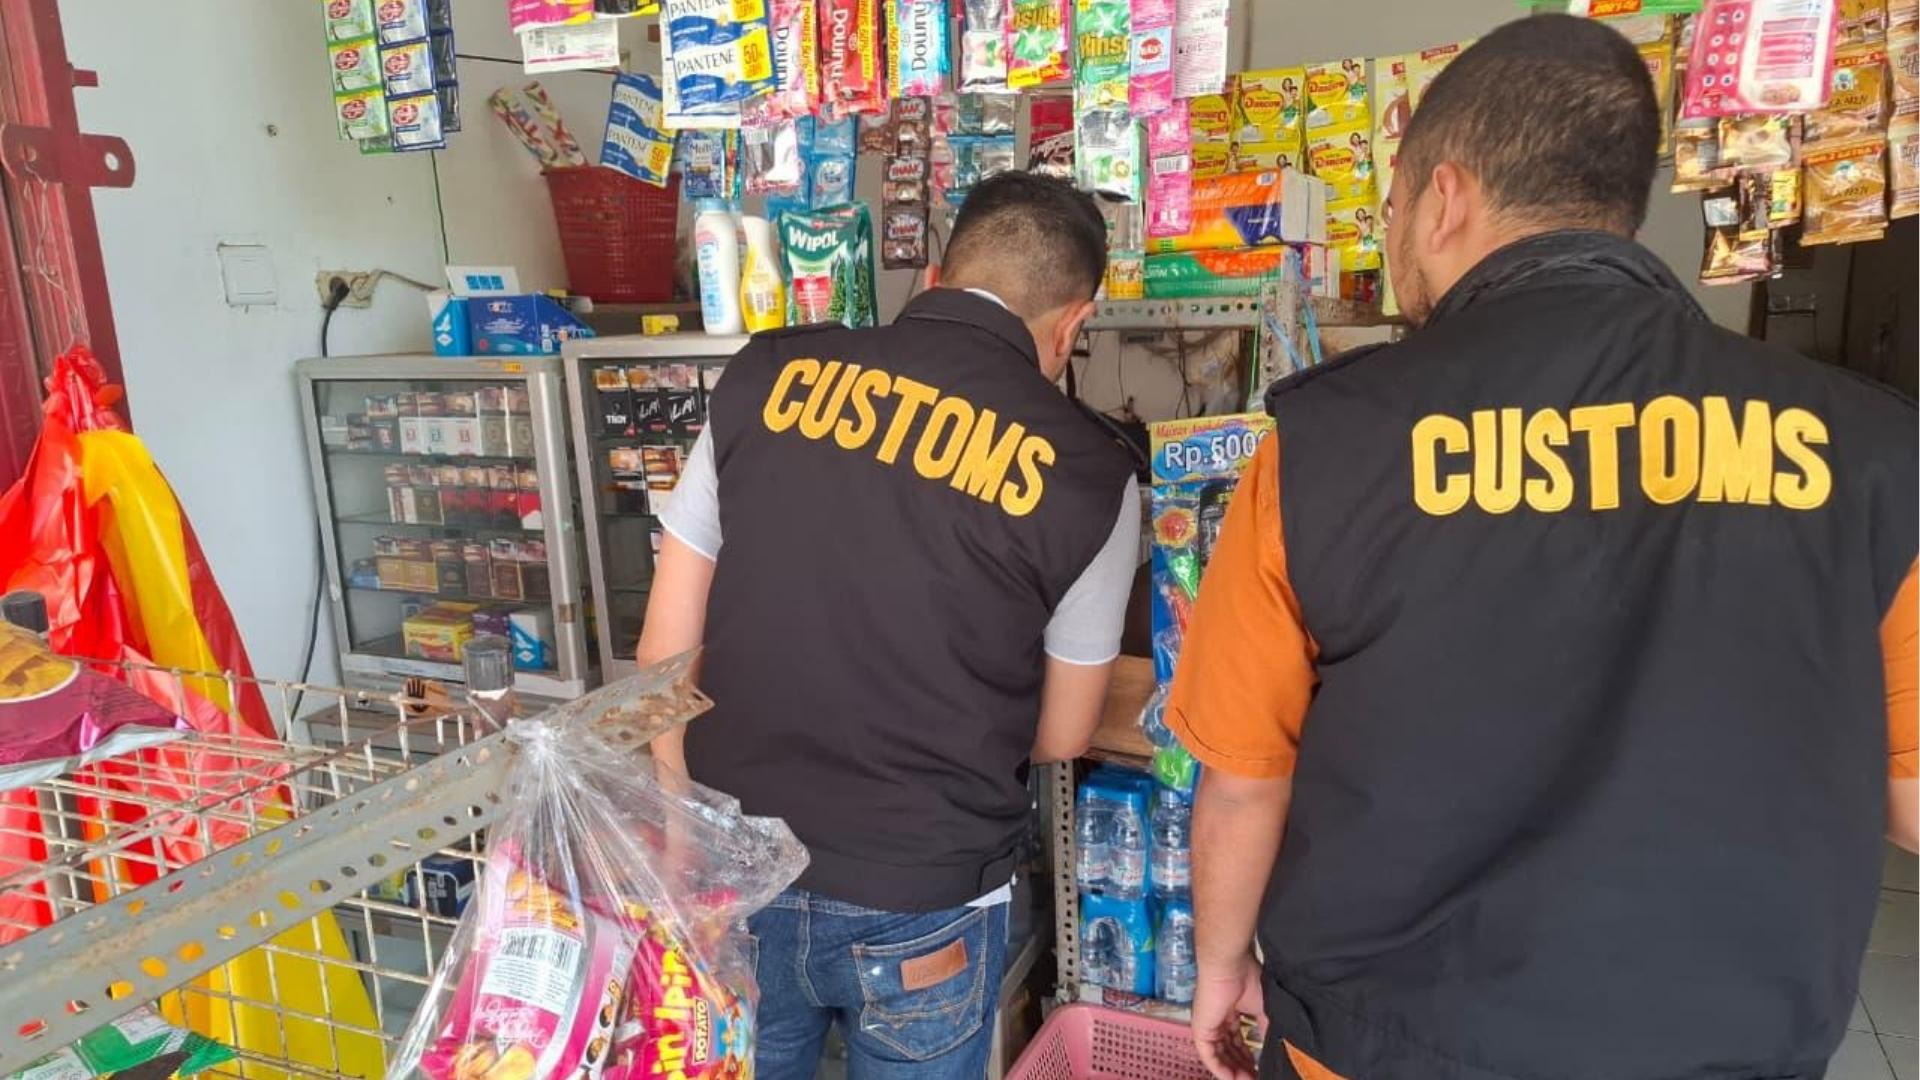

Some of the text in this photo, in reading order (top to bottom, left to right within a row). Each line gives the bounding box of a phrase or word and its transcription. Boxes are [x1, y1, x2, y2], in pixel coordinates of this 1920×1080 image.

[676, 48, 735, 74] PANTENE
[788, 225, 839, 252] WIPOL
[763, 358, 1056, 516] CUSTOMS
[1411, 395, 1832, 516] CUSTOMS
[695, 999, 708, 1062] POTATO
